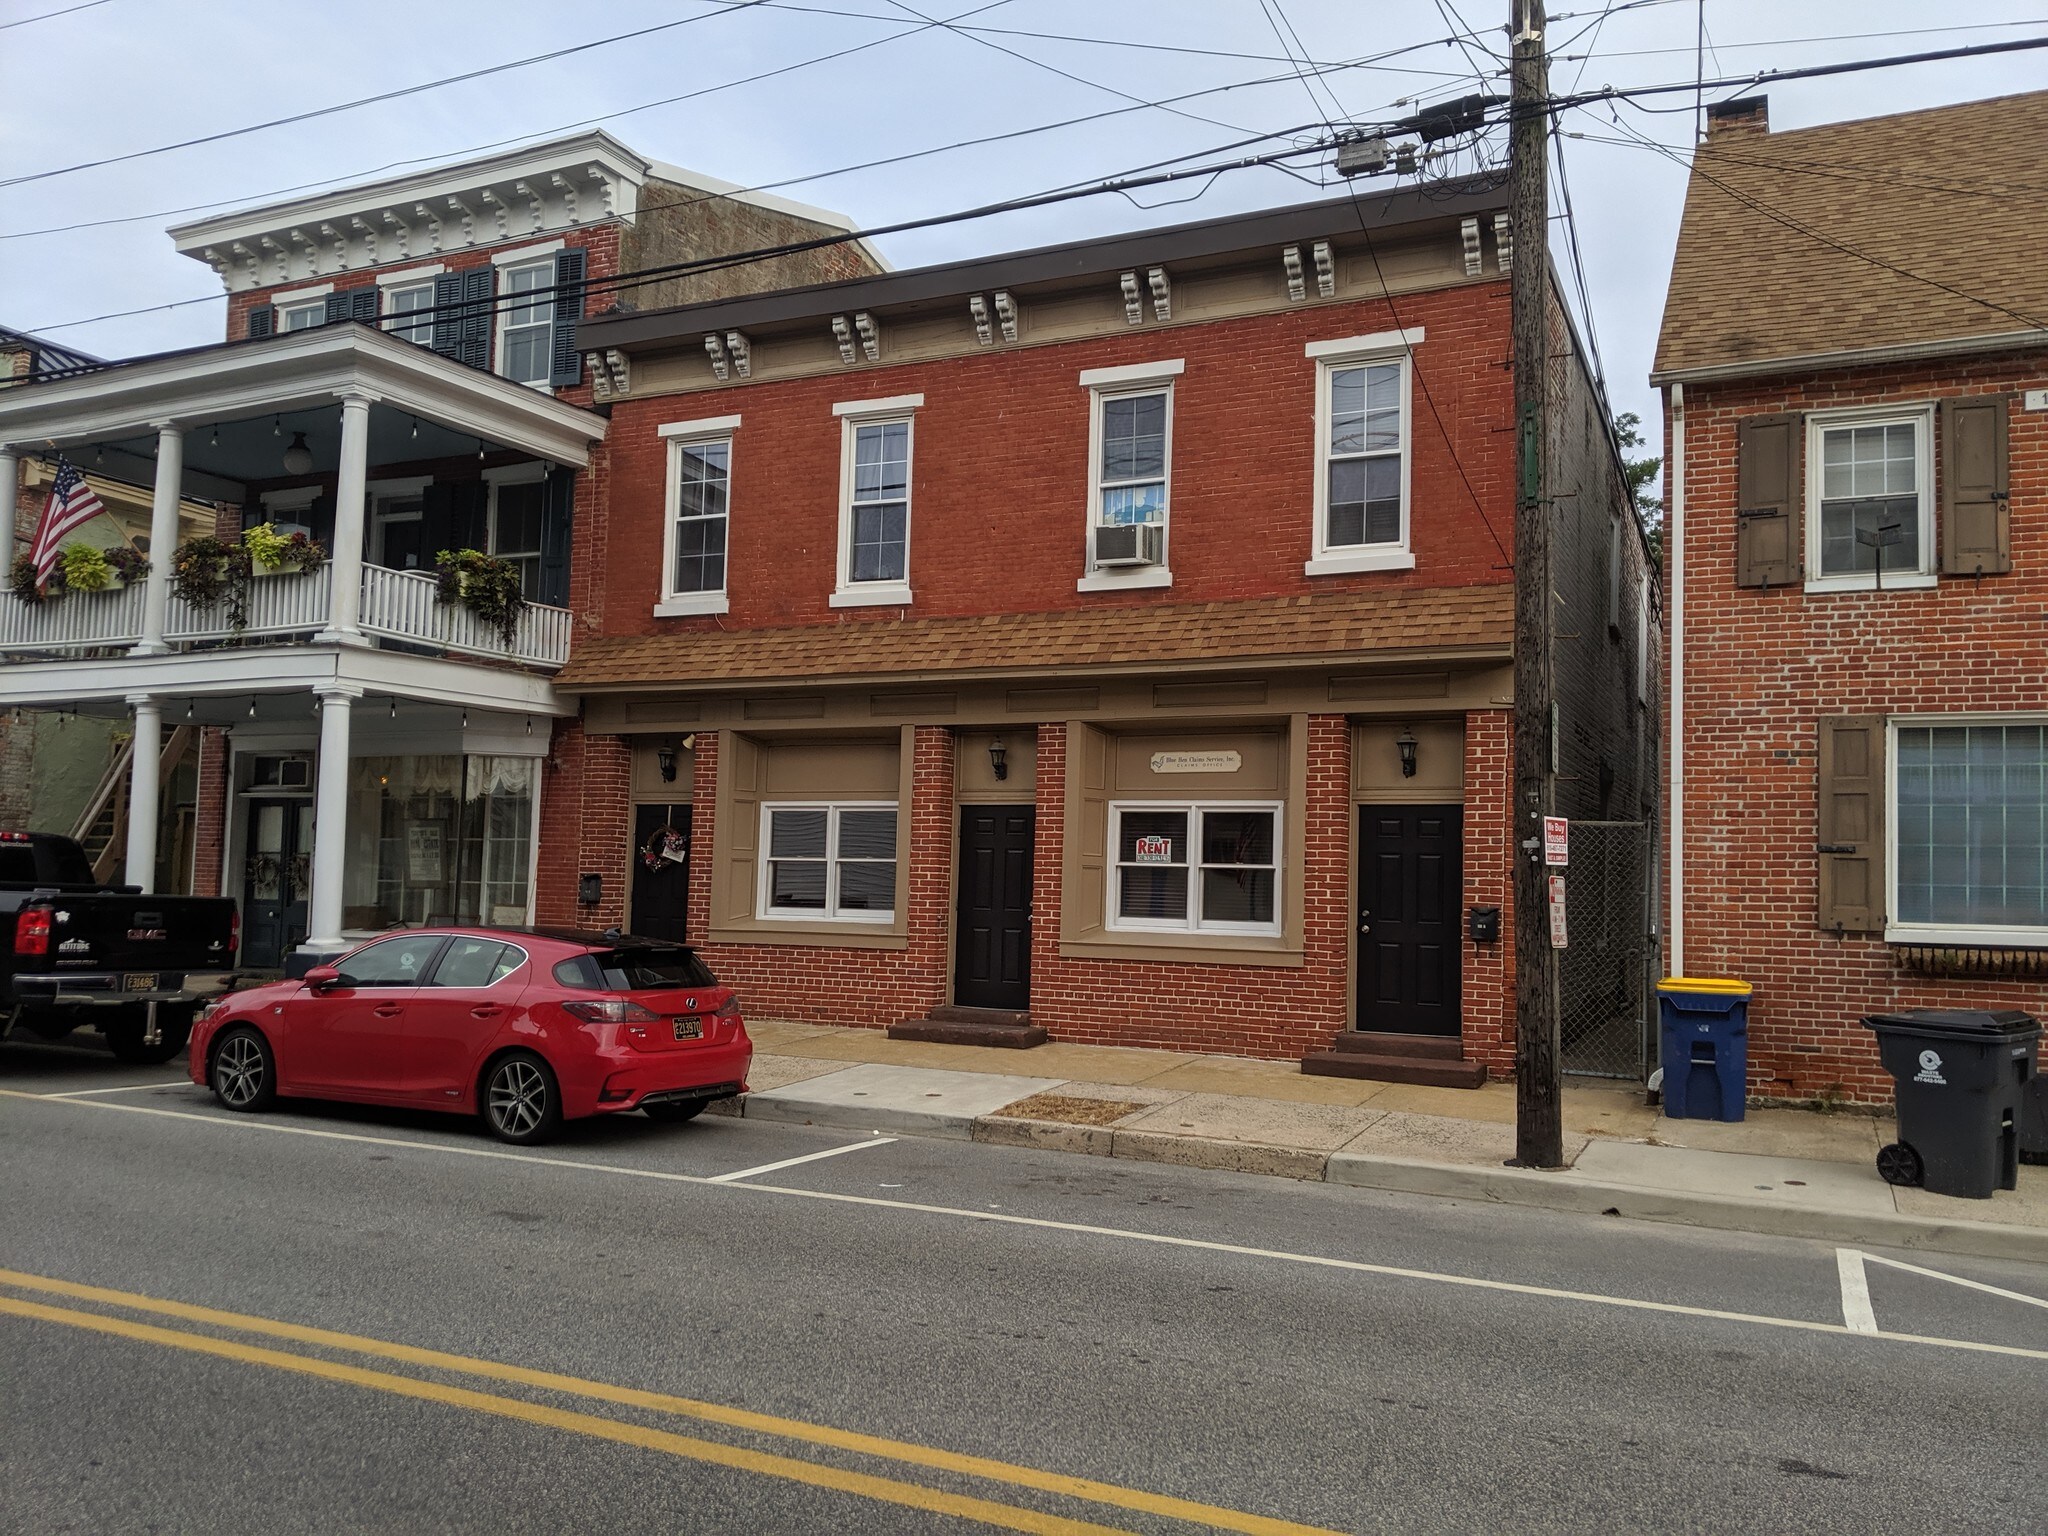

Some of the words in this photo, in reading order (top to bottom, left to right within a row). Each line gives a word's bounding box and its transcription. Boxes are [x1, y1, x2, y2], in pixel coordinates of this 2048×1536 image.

[1547, 821, 1555, 831] We
[1554, 822, 1565, 834] Buy
[1547, 831, 1565, 843] Houses
[1137, 839, 1169, 854] RENT
[127, 929, 167, 940] GMC
